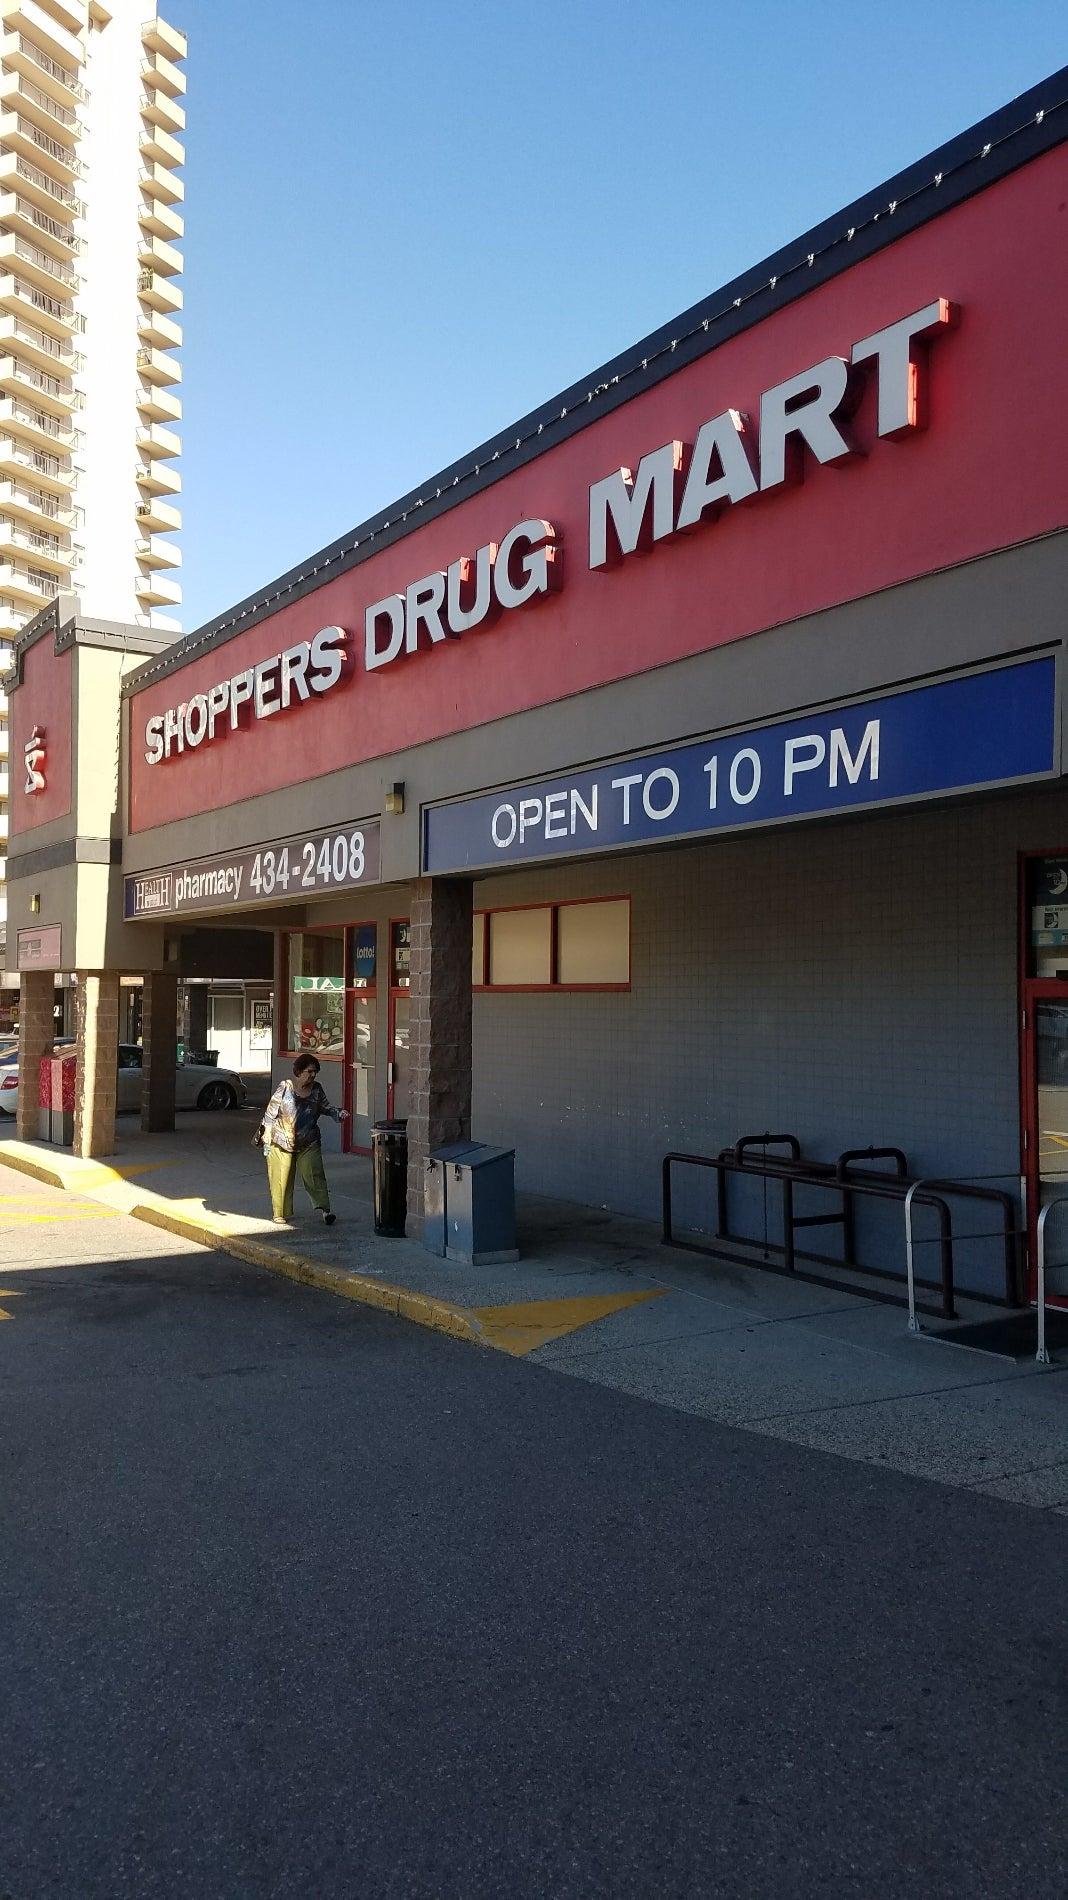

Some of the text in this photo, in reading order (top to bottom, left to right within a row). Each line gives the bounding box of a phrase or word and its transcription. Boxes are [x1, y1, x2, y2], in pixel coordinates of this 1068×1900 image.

[144, 297, 957, 766] SHOPPERS DRUG MART
[490, 719, 881, 849] OPEN TO 10 PM
[175, 831, 365, 908] pharmacy 434-2408
